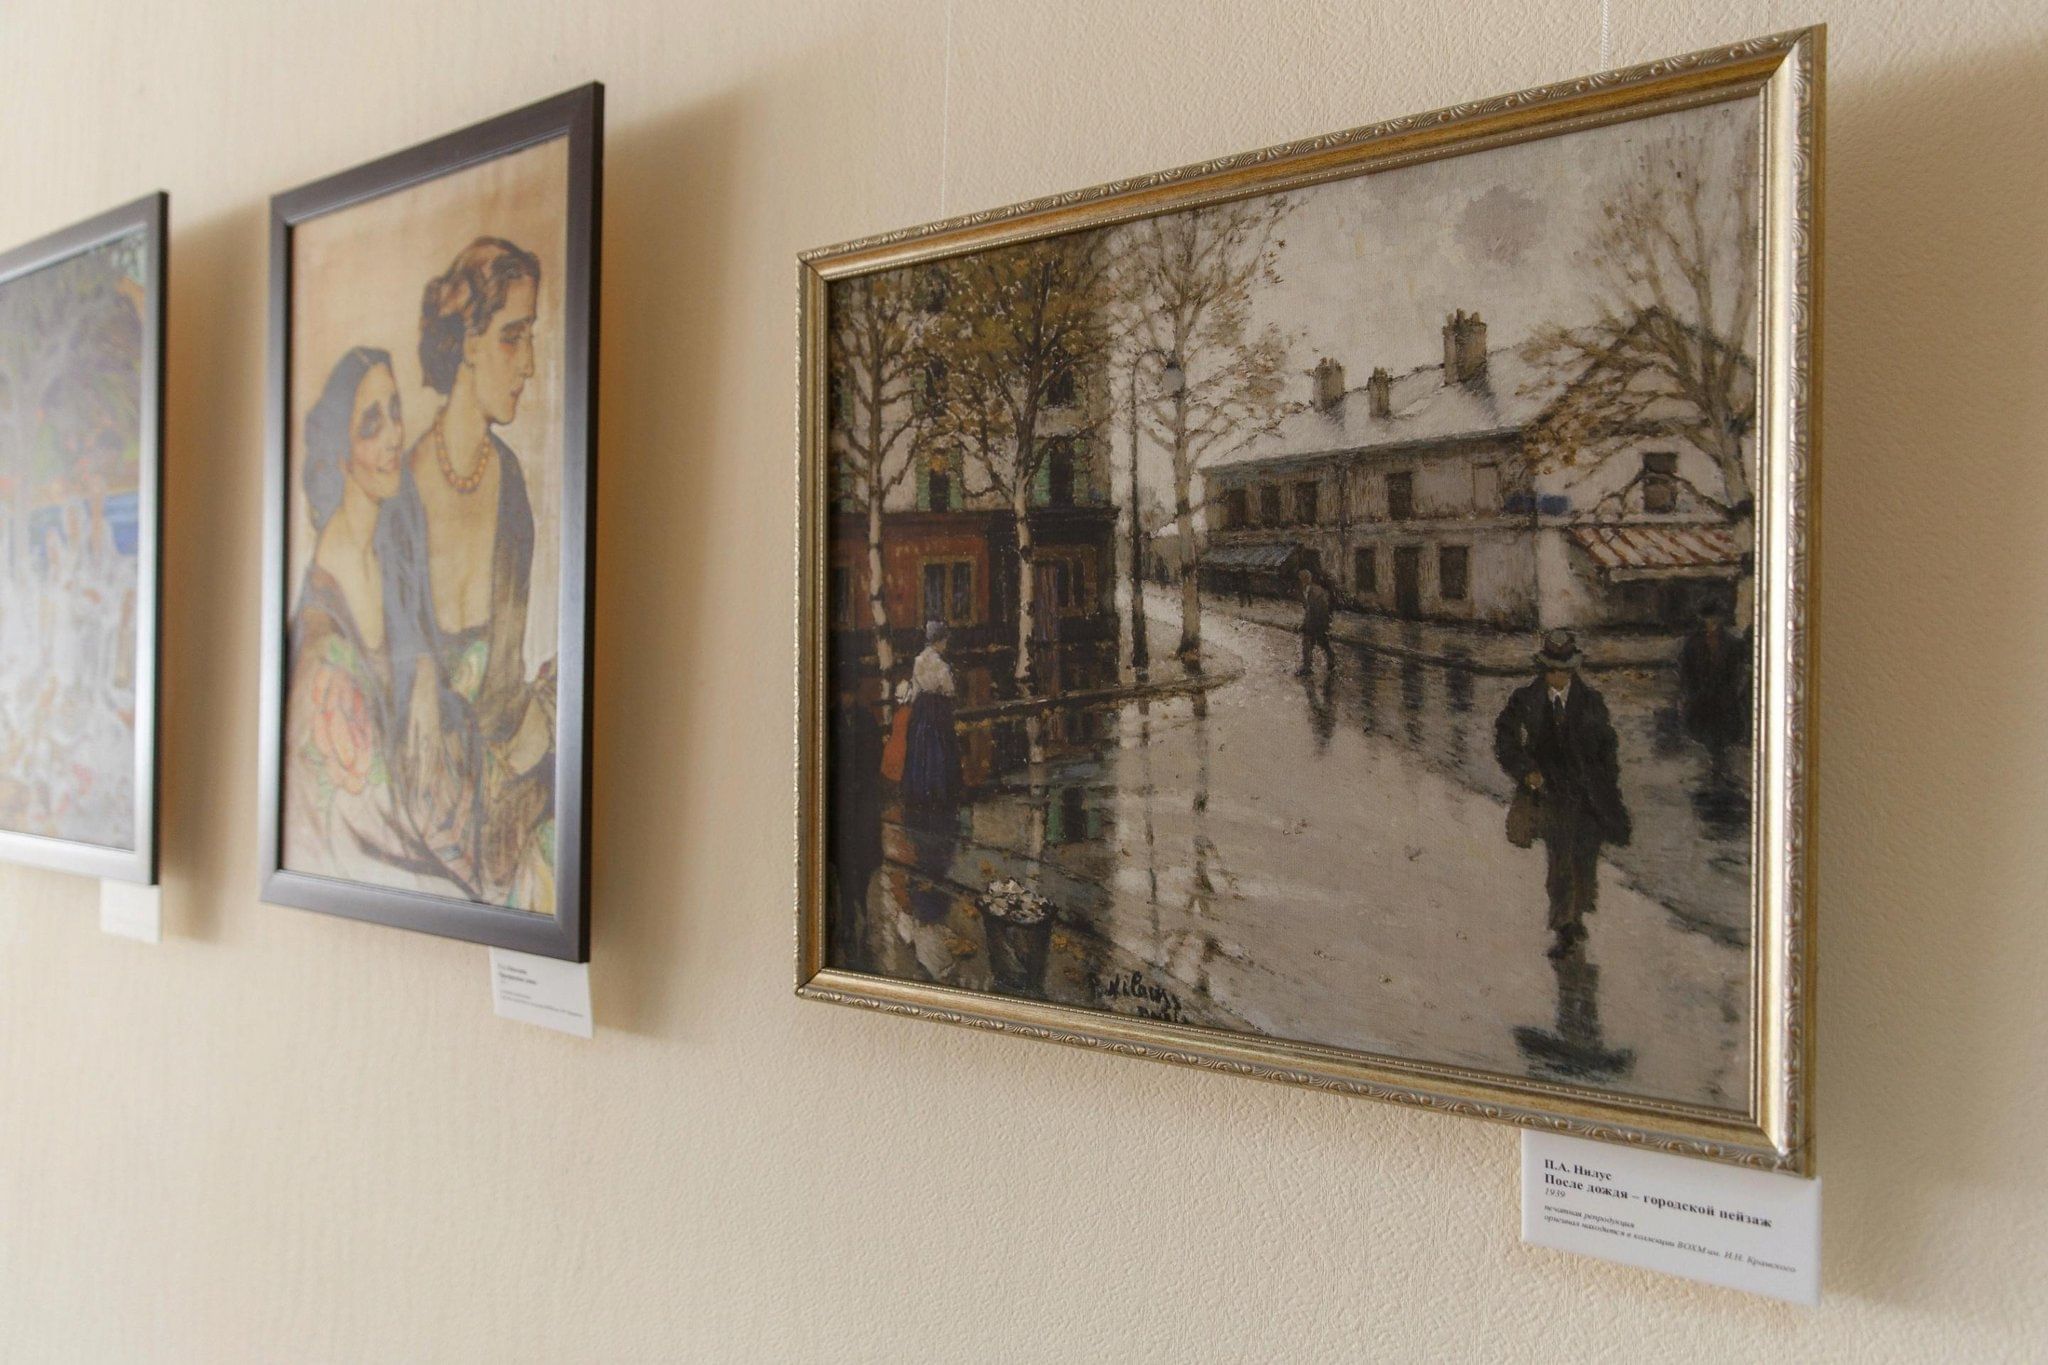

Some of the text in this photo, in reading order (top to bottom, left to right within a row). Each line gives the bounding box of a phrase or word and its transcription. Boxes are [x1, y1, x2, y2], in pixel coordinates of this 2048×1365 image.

[1545, 1159, 1612, 1181] П.А. Нилус
[1545, 1187, 1566, 1198] 1939
[1545, 1174, 1583, 1190] После
[1586, 1183, 1628, 1199] дождя
[1643, 1194, 1715, 1216] городской
[1719, 1210, 1772, 1228] пейзаж
[1583, 1212, 1635, 1229] репродукция
